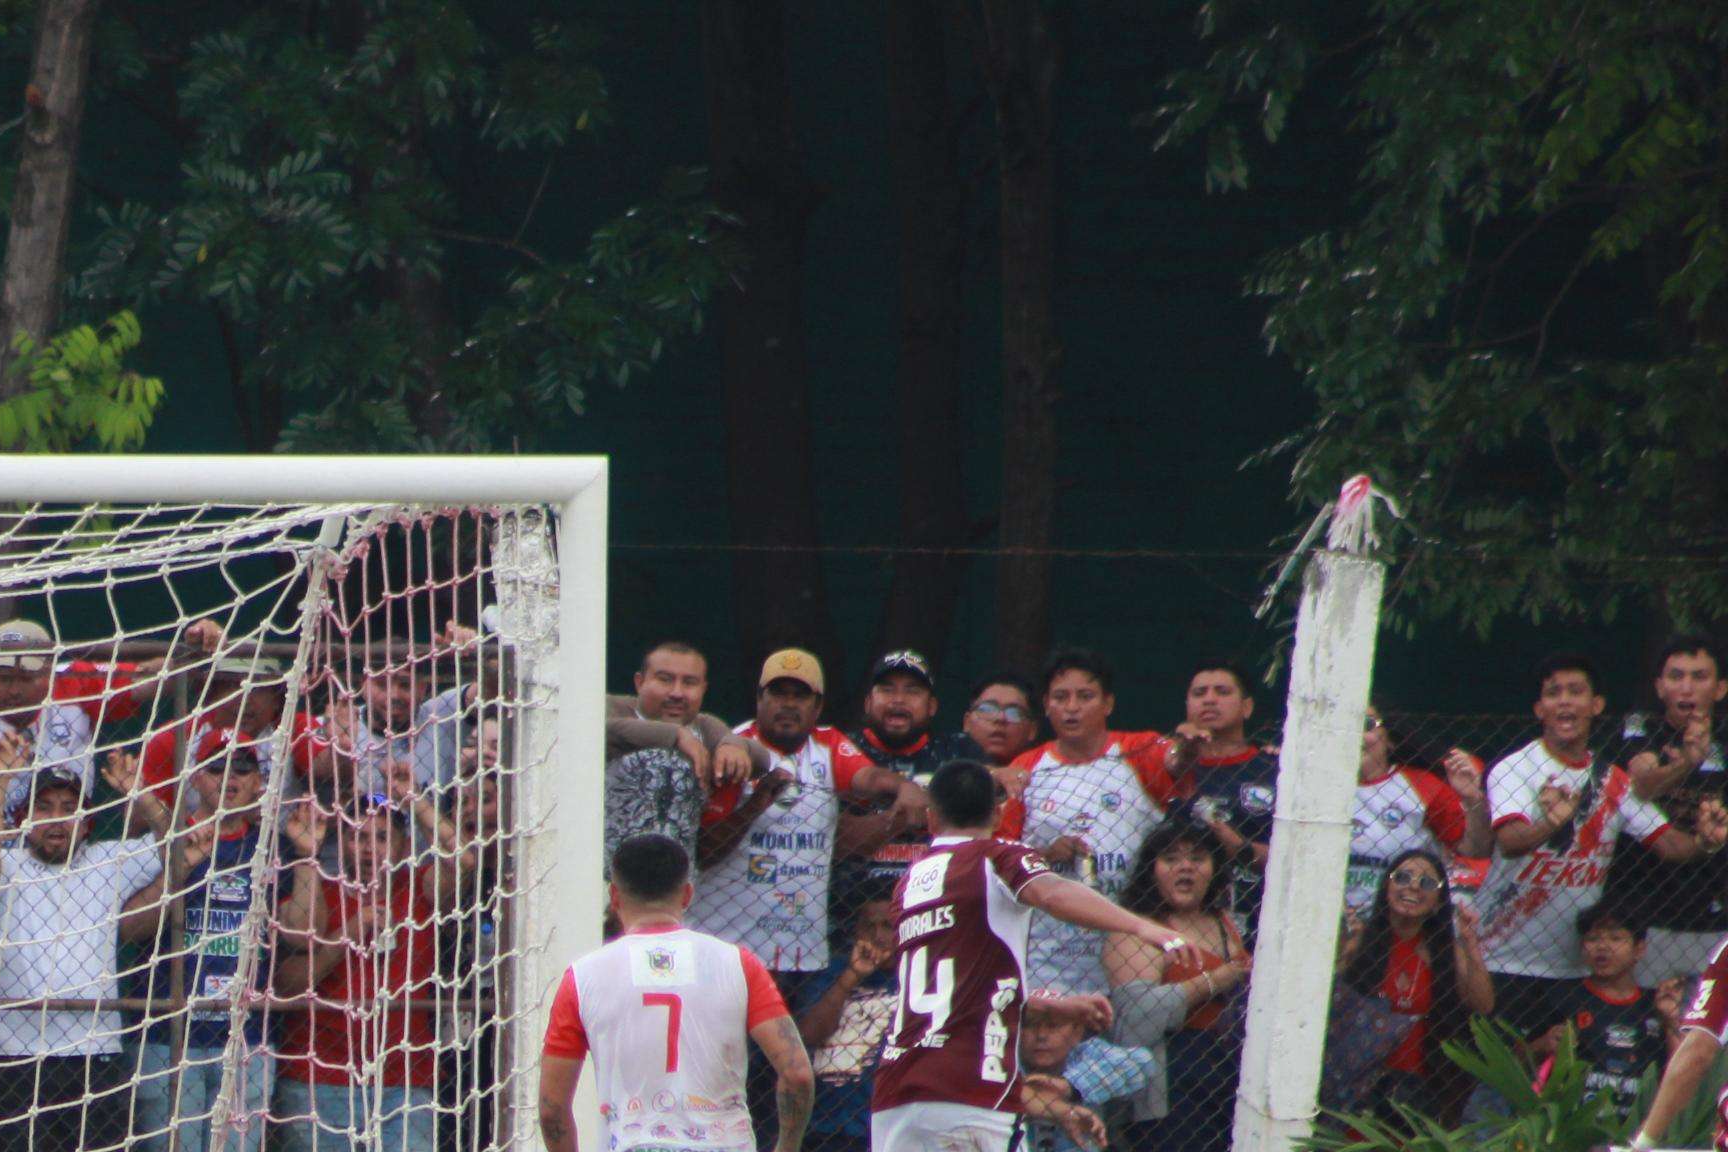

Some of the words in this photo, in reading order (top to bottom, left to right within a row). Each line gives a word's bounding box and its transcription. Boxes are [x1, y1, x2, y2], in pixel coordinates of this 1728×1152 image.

[642, 992, 683, 1073] 7
[888, 946, 955, 1046] 14
[981, 977, 1019, 1083] PEPSI
